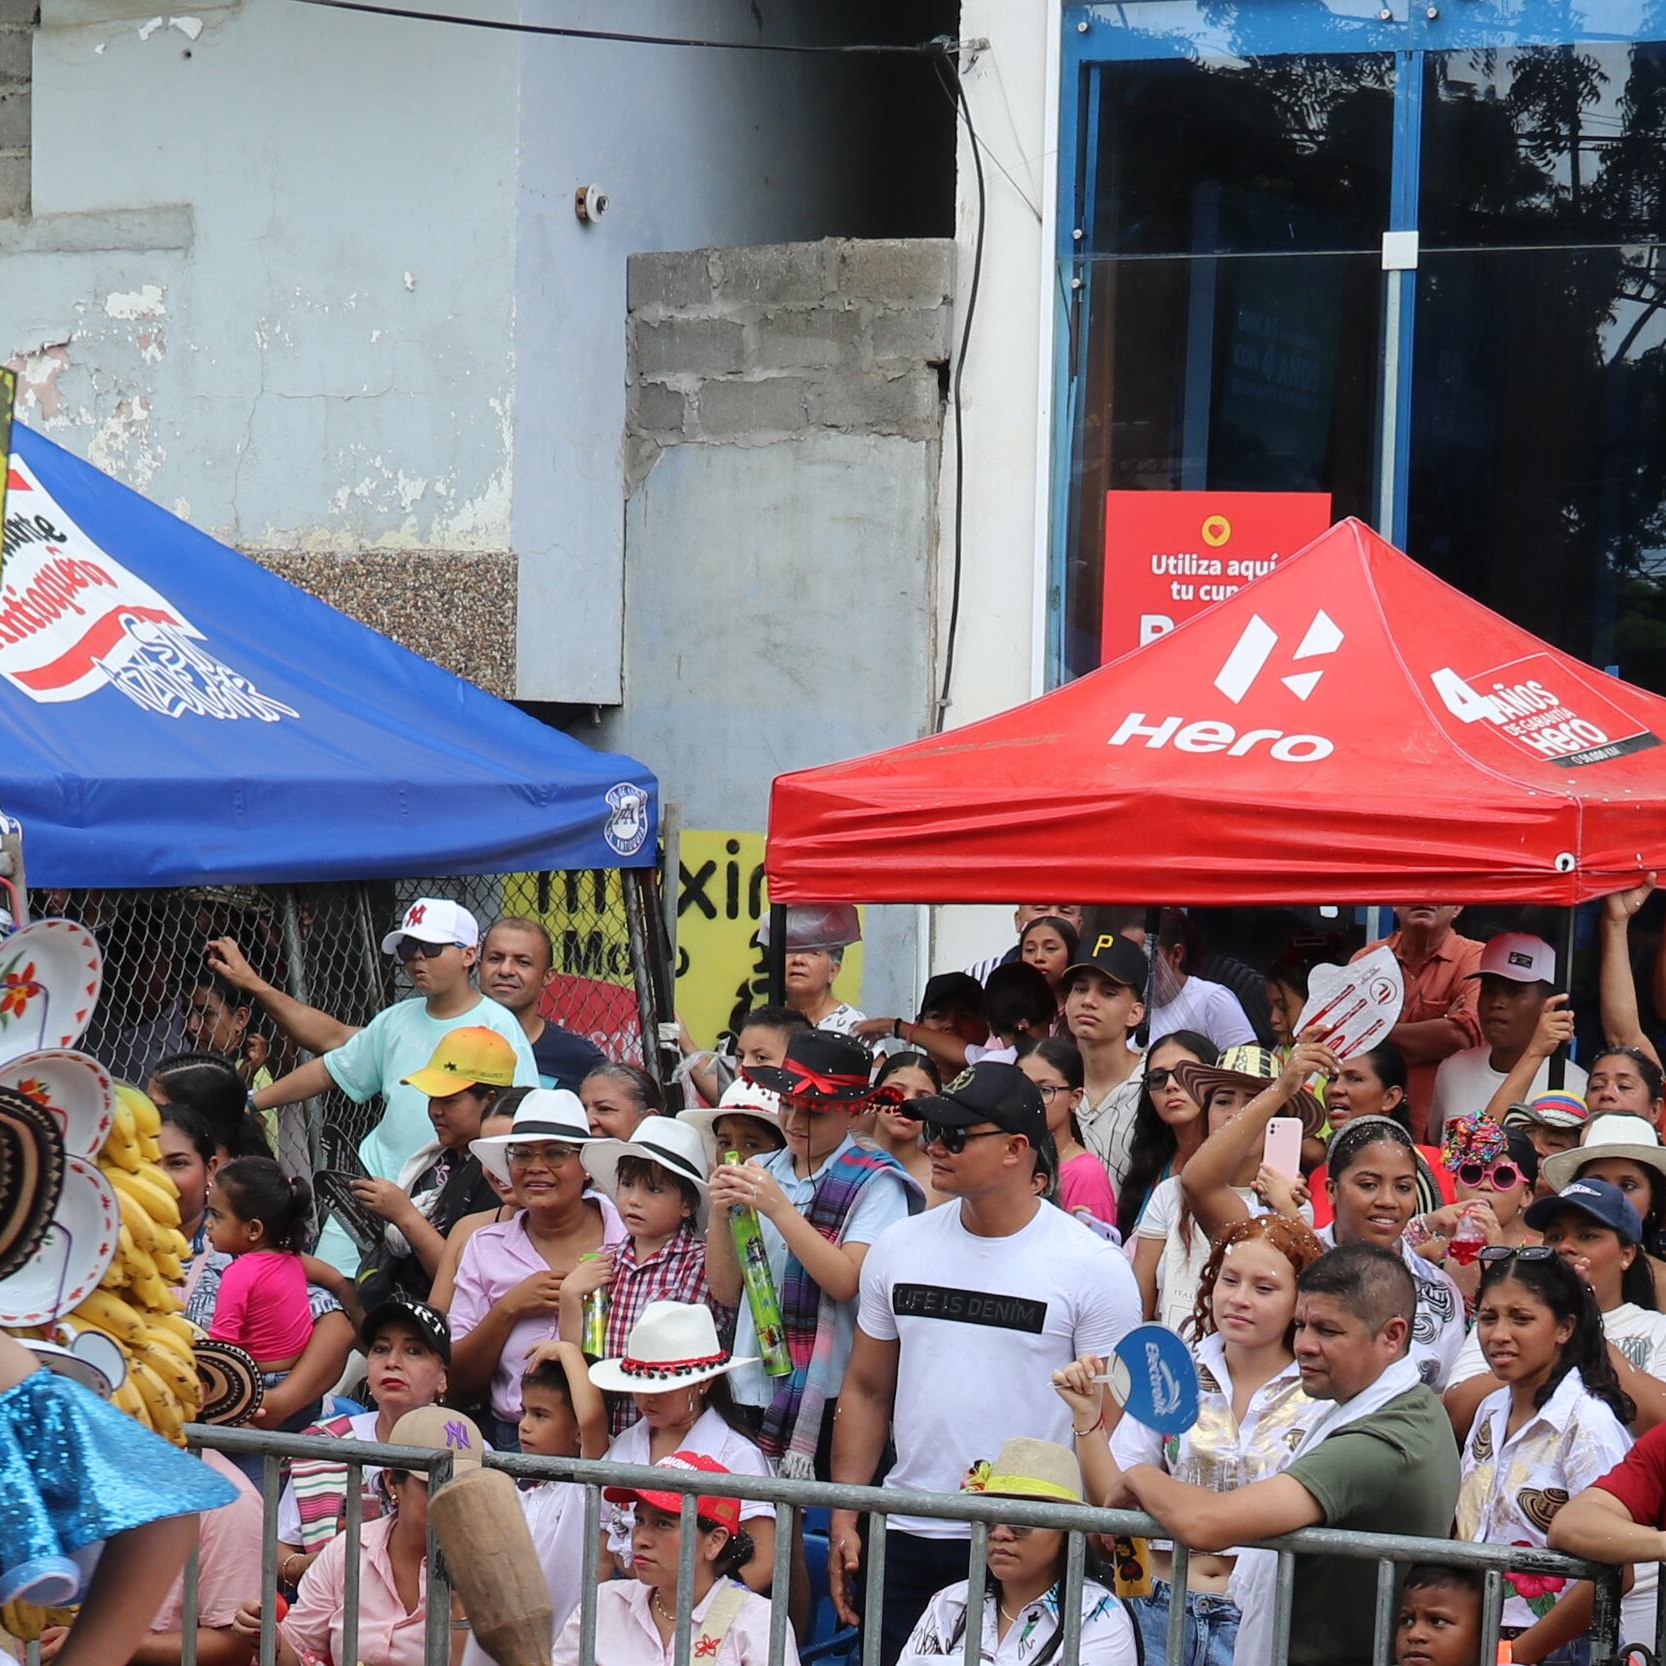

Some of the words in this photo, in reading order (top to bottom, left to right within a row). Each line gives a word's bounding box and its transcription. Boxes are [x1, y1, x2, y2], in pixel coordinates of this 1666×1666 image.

[1151, 553, 1222, 576] Utiliza
[1226, 553, 1279, 581] aquí
[1171, 581, 1194, 601] tu
[1199, 584, 1239, 601] cup
[1430, 667, 1506, 725] 4
[1488, 680, 1560, 721] AÑOS
[1107, 712, 1335, 763] Hero
[1502, 720, 1524, 737] DE
[1518, 718, 1609, 757] Hero
[1092, 934, 1114, 958] P
[895, 1288, 939, 1310] LIFE
[941, 1294, 963, 1313] IS
[967, 1298, 1035, 1325] DENIM
